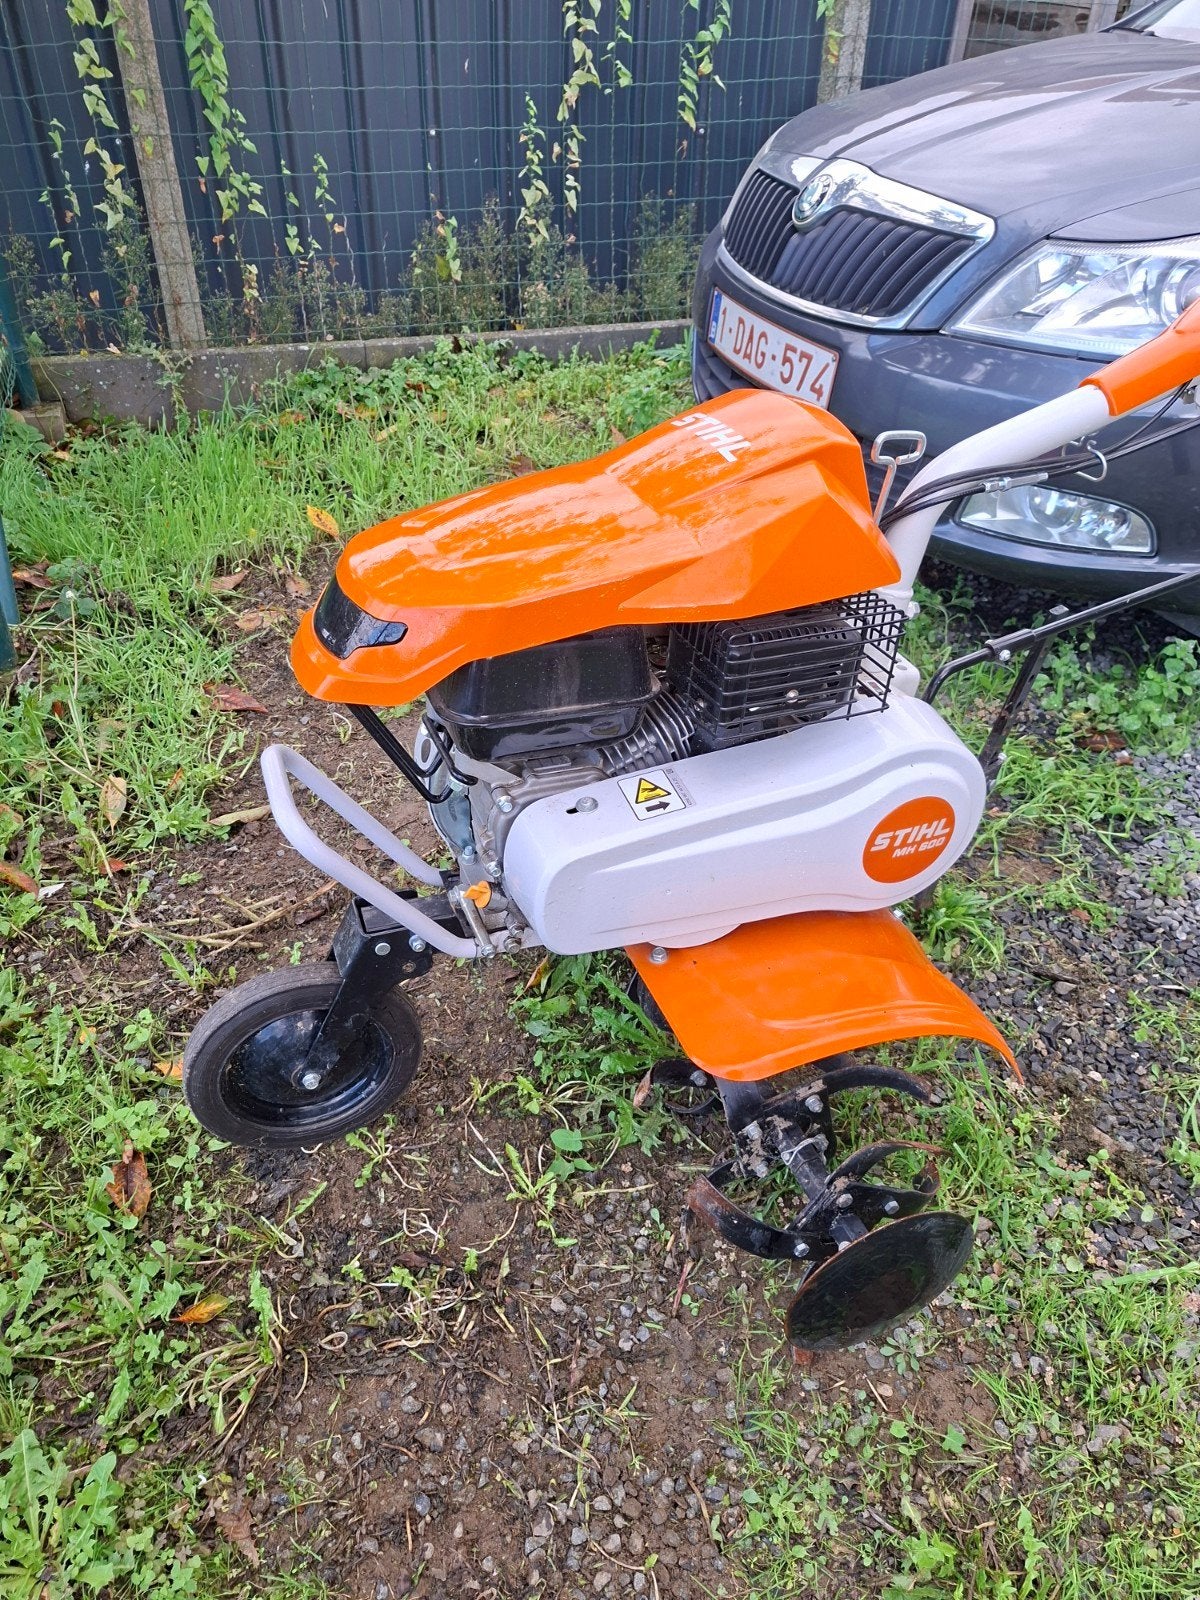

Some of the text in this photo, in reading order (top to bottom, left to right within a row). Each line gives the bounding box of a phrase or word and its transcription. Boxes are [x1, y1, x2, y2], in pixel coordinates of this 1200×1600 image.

[670, 412, 752, 463] STIHL
[870, 818, 951, 852] STIHL
[891, 836, 946, 858] MH 600
